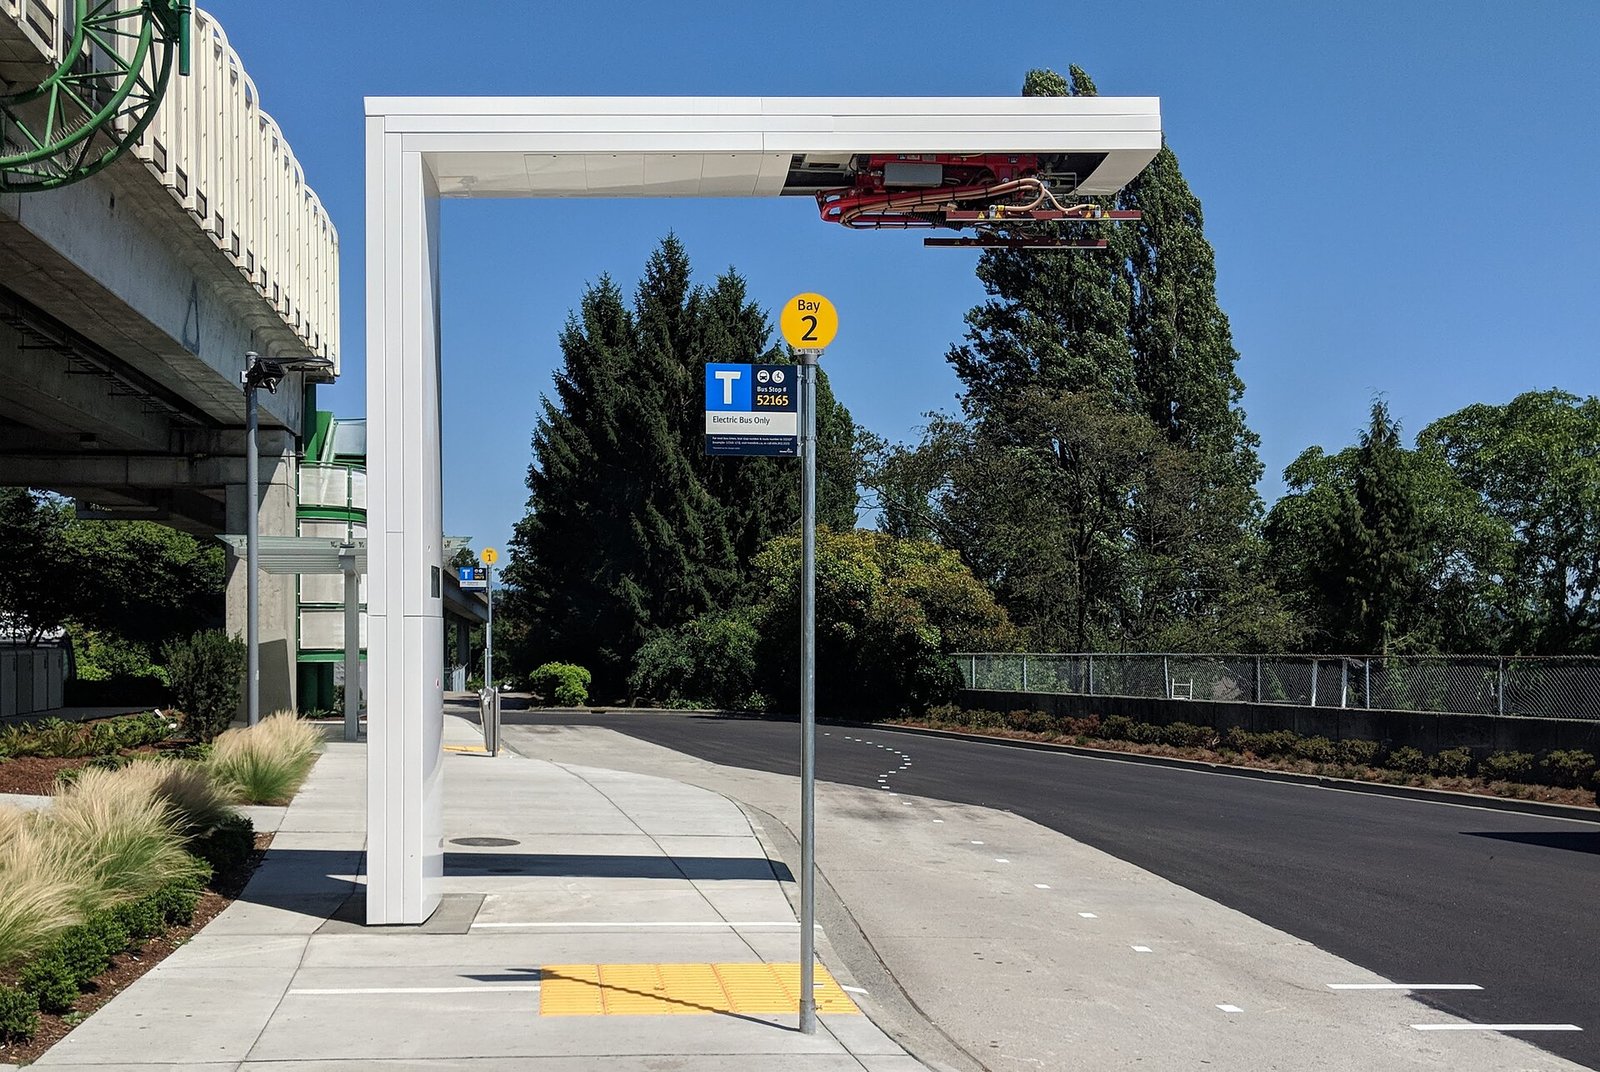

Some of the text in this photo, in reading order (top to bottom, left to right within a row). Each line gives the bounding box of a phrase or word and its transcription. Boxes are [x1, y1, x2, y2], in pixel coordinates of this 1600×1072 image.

[798, 300, 820, 313] Bay
[801, 315, 818, 341] 2
[714, 371, 741, 404] T
[768, 386, 782, 394] Stop
[757, 395, 789, 405] 52165
[712, 416, 770, 426] Electric Bus Only
[462, 570, 470, 579] T
